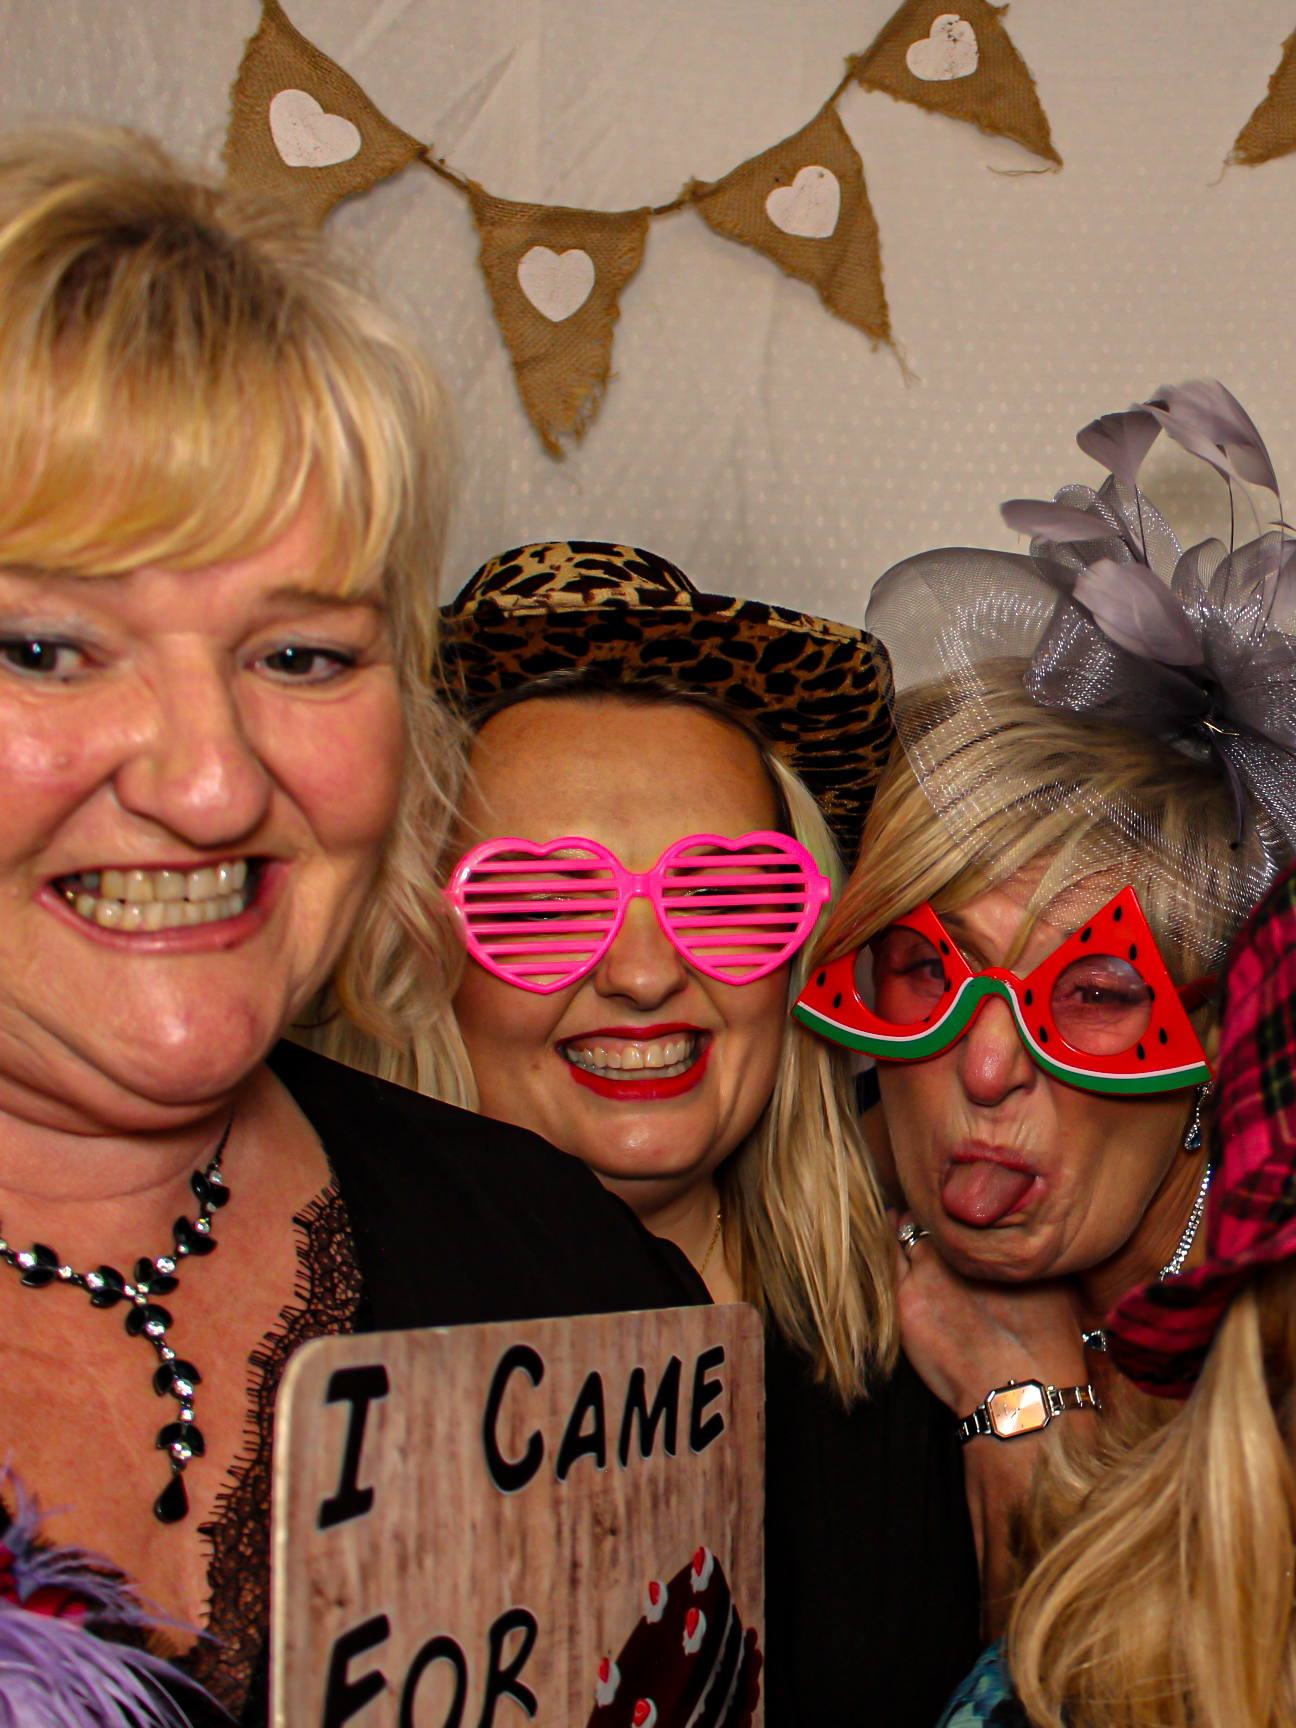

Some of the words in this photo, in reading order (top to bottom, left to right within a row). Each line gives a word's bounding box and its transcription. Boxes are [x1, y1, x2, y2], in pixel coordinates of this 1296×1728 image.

[318, 1364, 389, 1530] I
[483, 1344, 725, 1493] CAME
[323, 1608, 538, 1728] FOR
